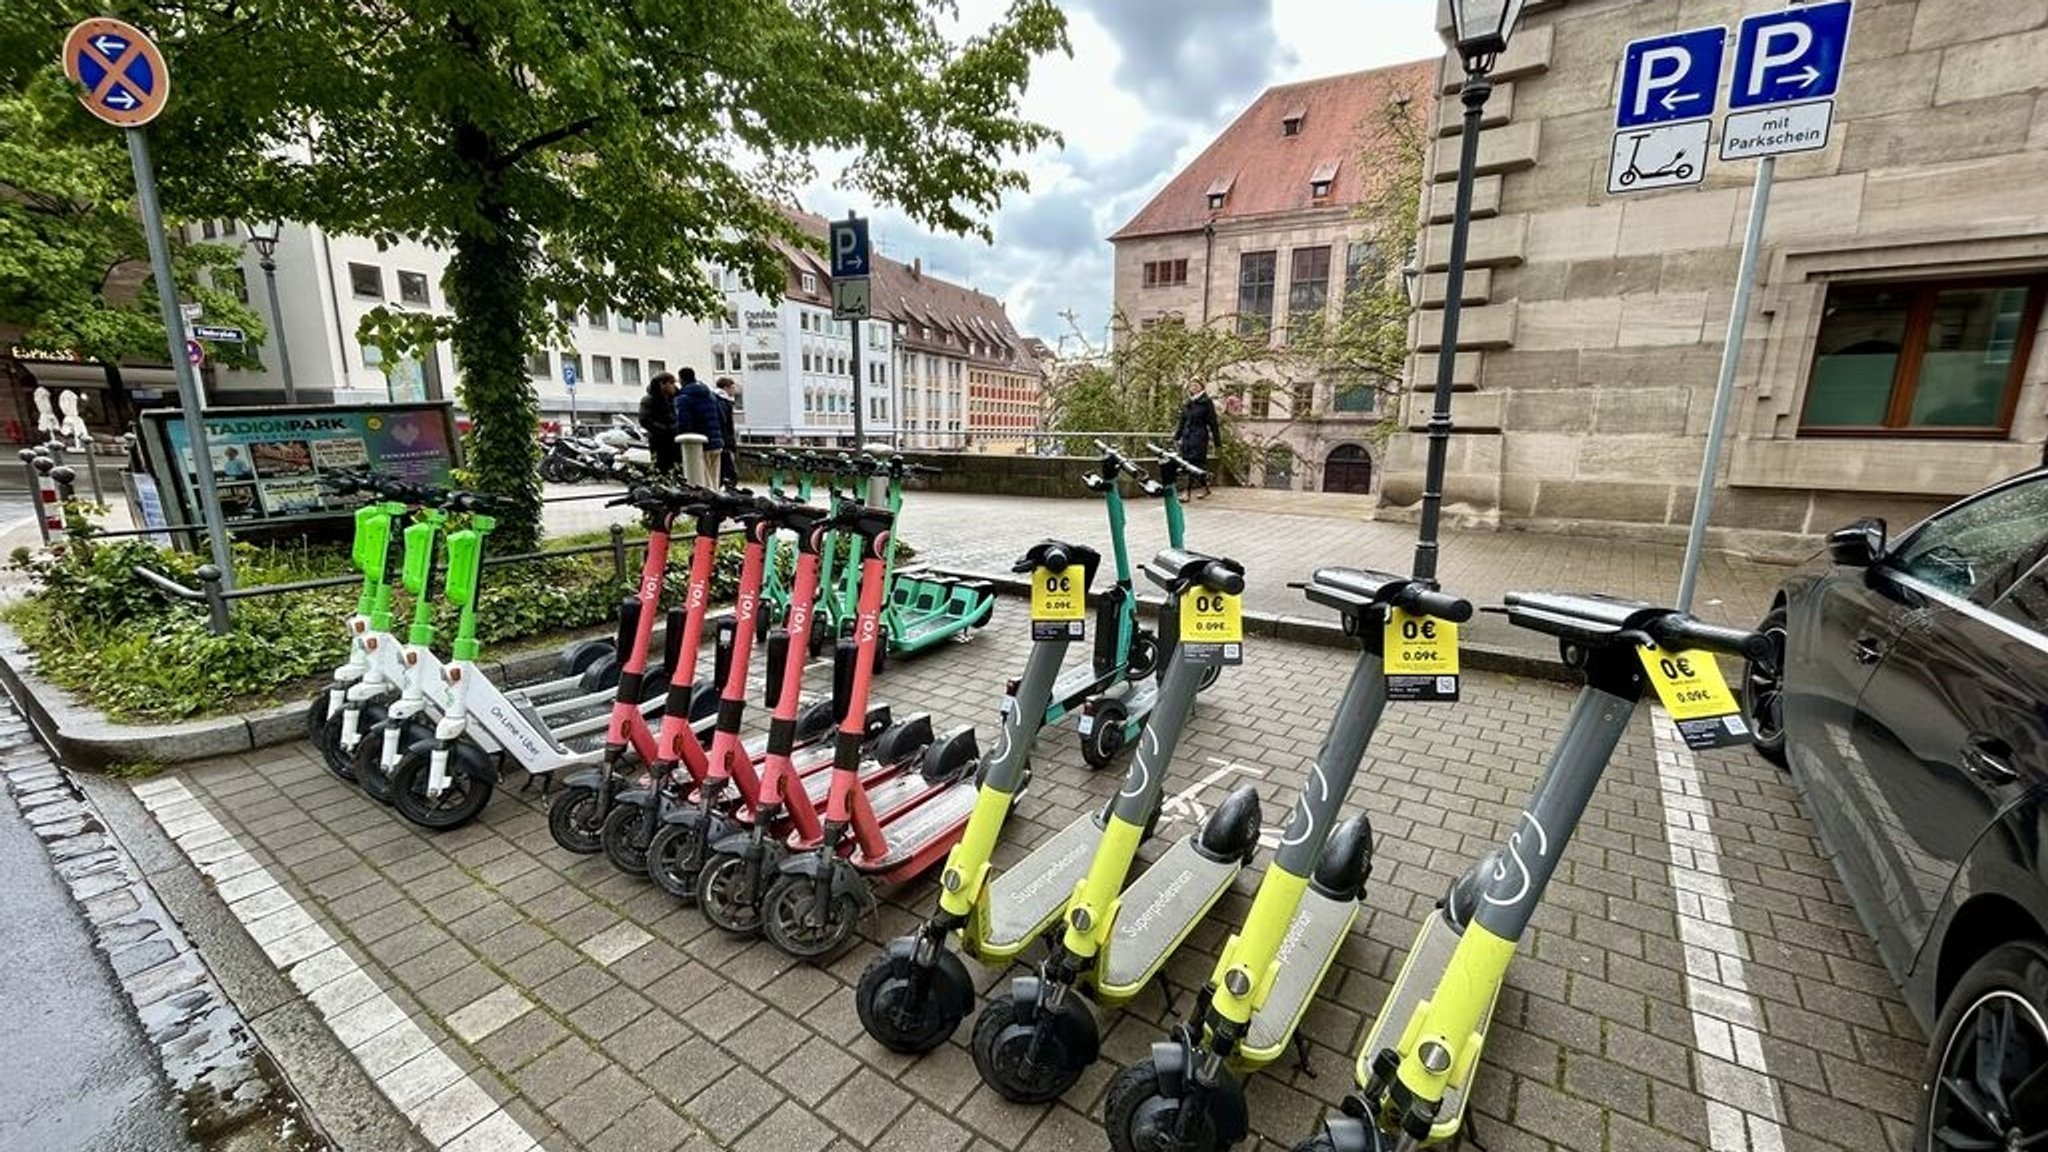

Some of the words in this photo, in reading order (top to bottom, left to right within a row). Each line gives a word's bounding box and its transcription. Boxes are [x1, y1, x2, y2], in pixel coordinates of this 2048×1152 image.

[1748, 22, 1813, 96] P
[1633, 46, 1691, 116] P
[1727, 128, 1820, 150] Parkschein
[1762, 116, 1789, 131] mit
[836, 227, 857, 271] P
[204, 418, 347, 436] TADIONPARK
[645, 574, 659, 600] voi.
[690, 579, 705, 609] voi.
[741, 590, 755, 621] voi.
[792, 602, 808, 635] voi.
[862, 609, 877, 643] voi.
[1121, 869, 1195, 938] Superpedestrian
